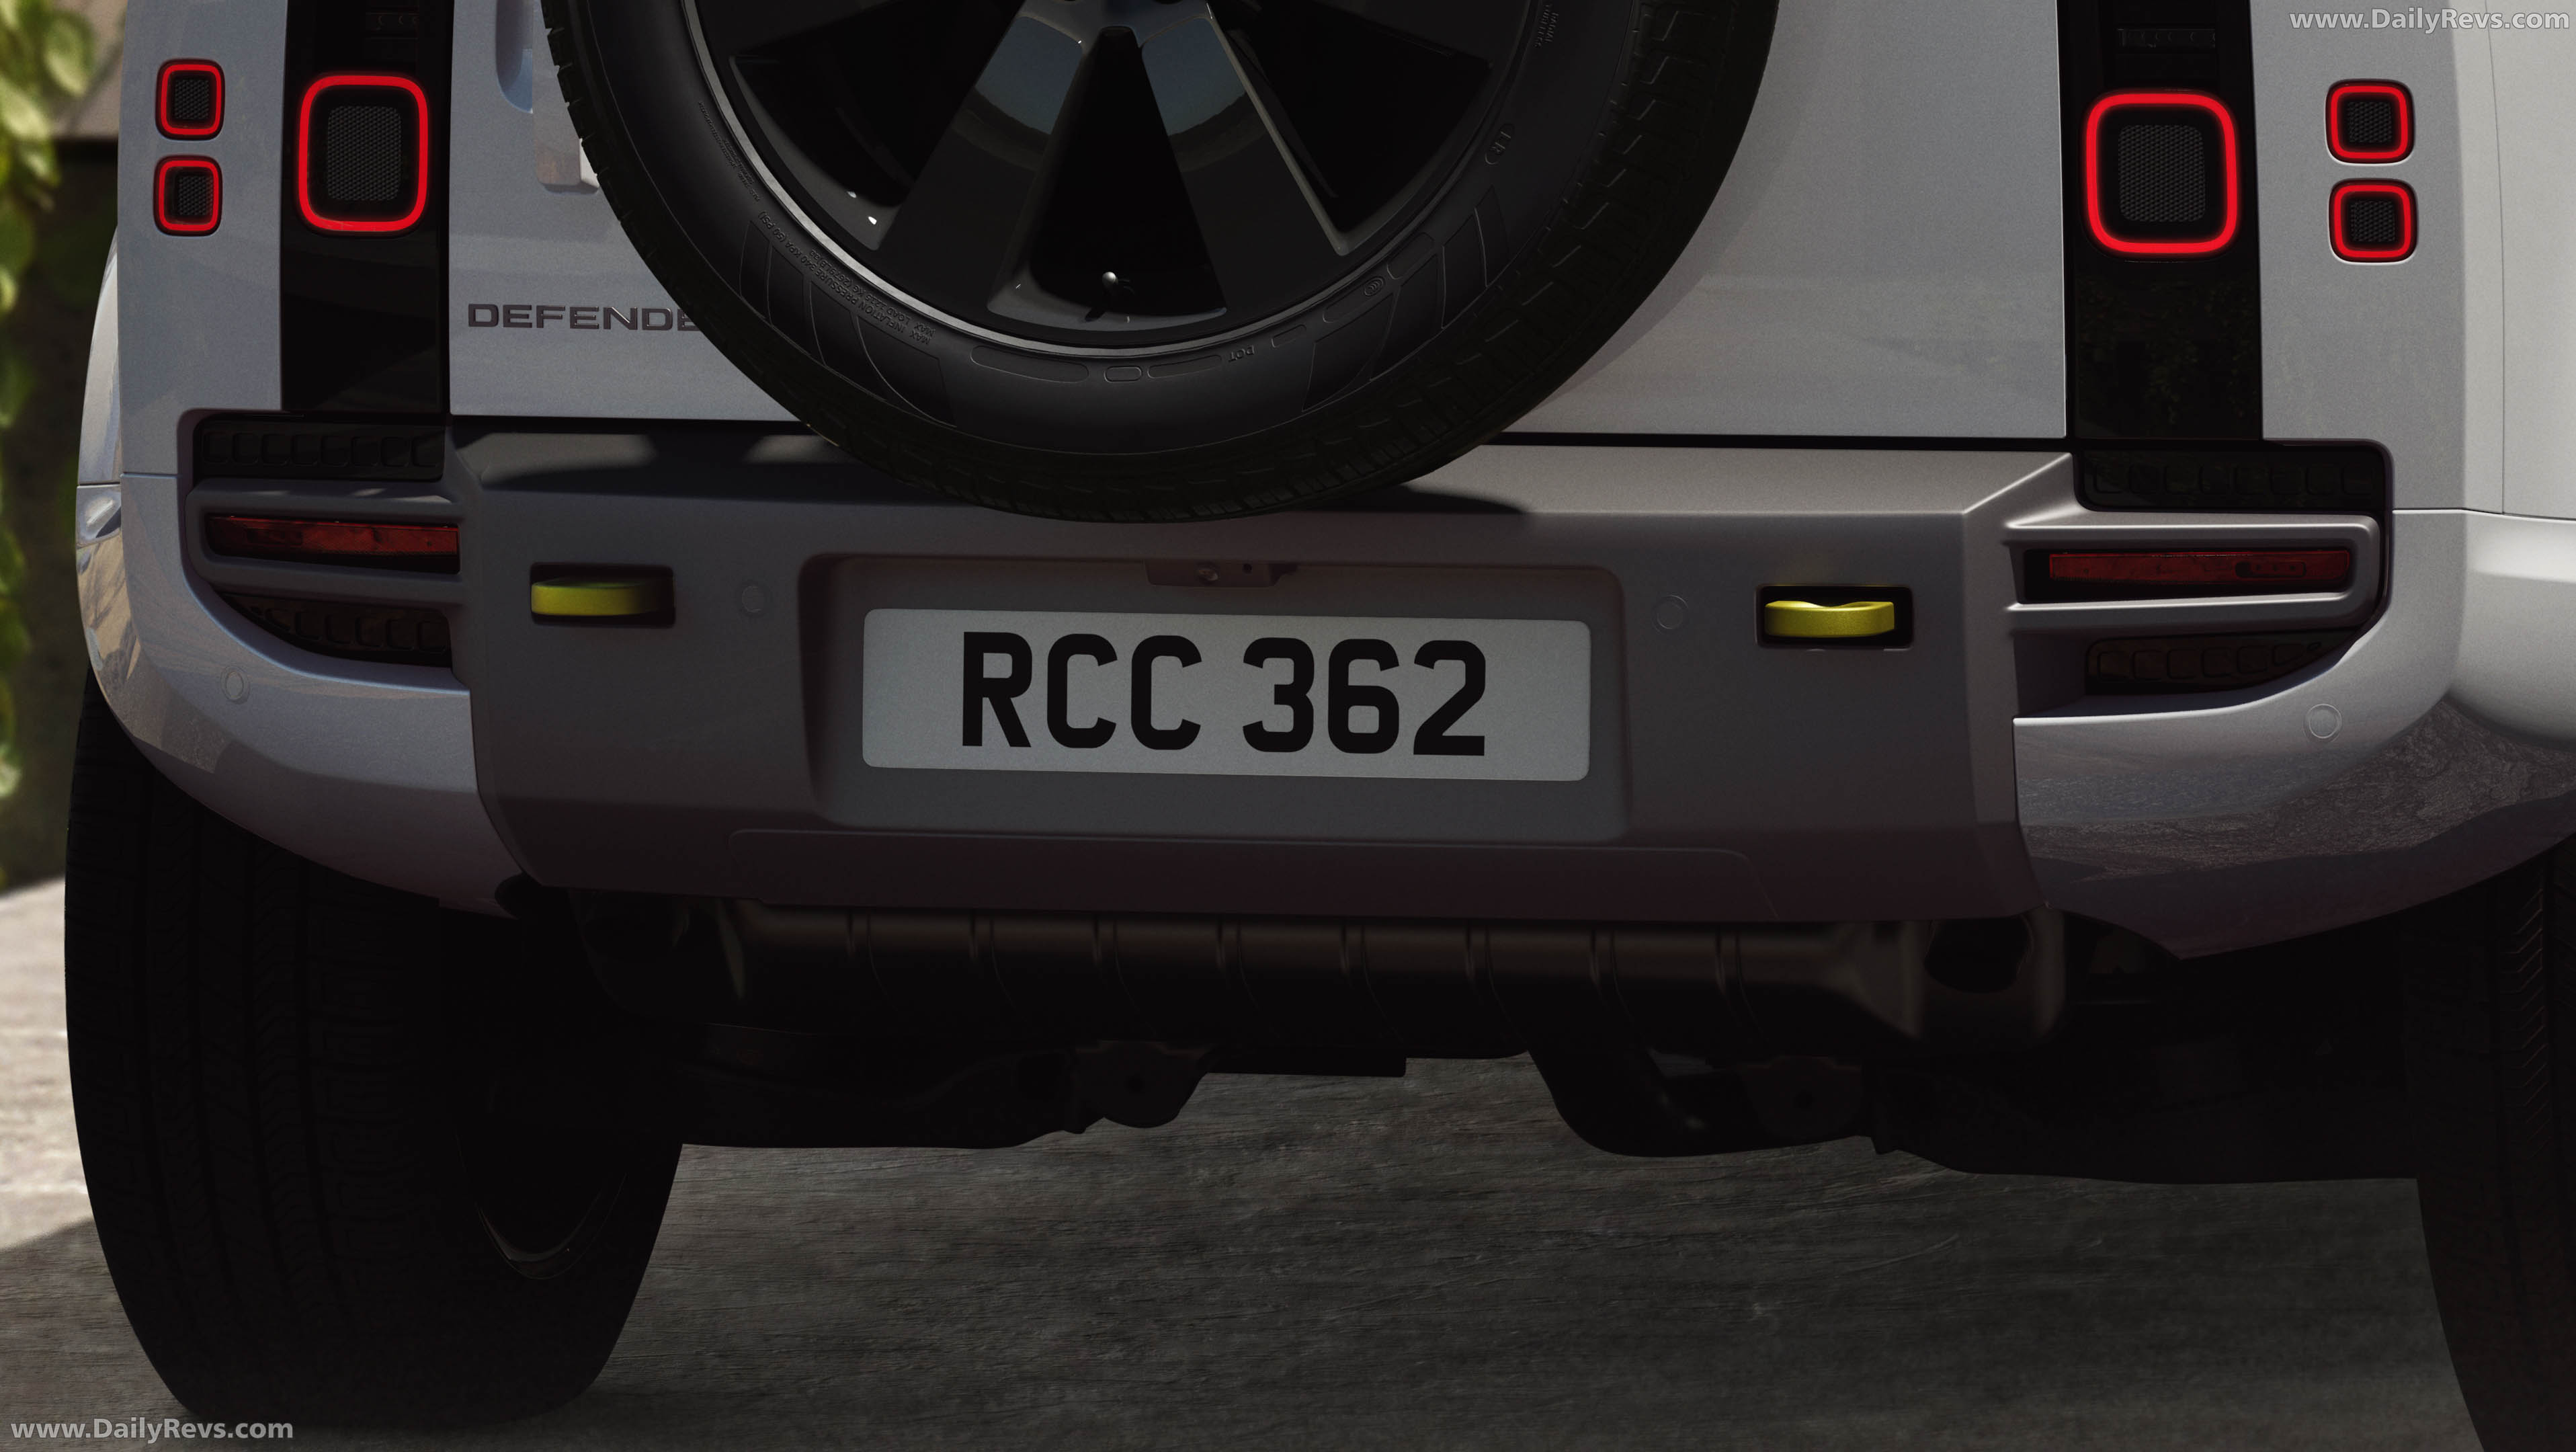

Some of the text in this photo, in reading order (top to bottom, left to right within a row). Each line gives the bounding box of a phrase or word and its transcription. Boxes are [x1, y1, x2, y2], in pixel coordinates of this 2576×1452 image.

[758, 211, 774, 229] PSI)
[784, 241, 802, 258] KPA
[800, 255, 817, 271] 340
[814, 268, 858, 305] PRESSURE
[851, 284, 865, 296] KG
[858, 301, 905, 333] INFLATION
[886, 307, 910, 325] LOAD
[909, 329, 931, 345] MAX
[913, 322, 936, 337] MAX
[1228, 344, 1255, 362] DOT
[962, 632, 1487, 756] RCC 362
